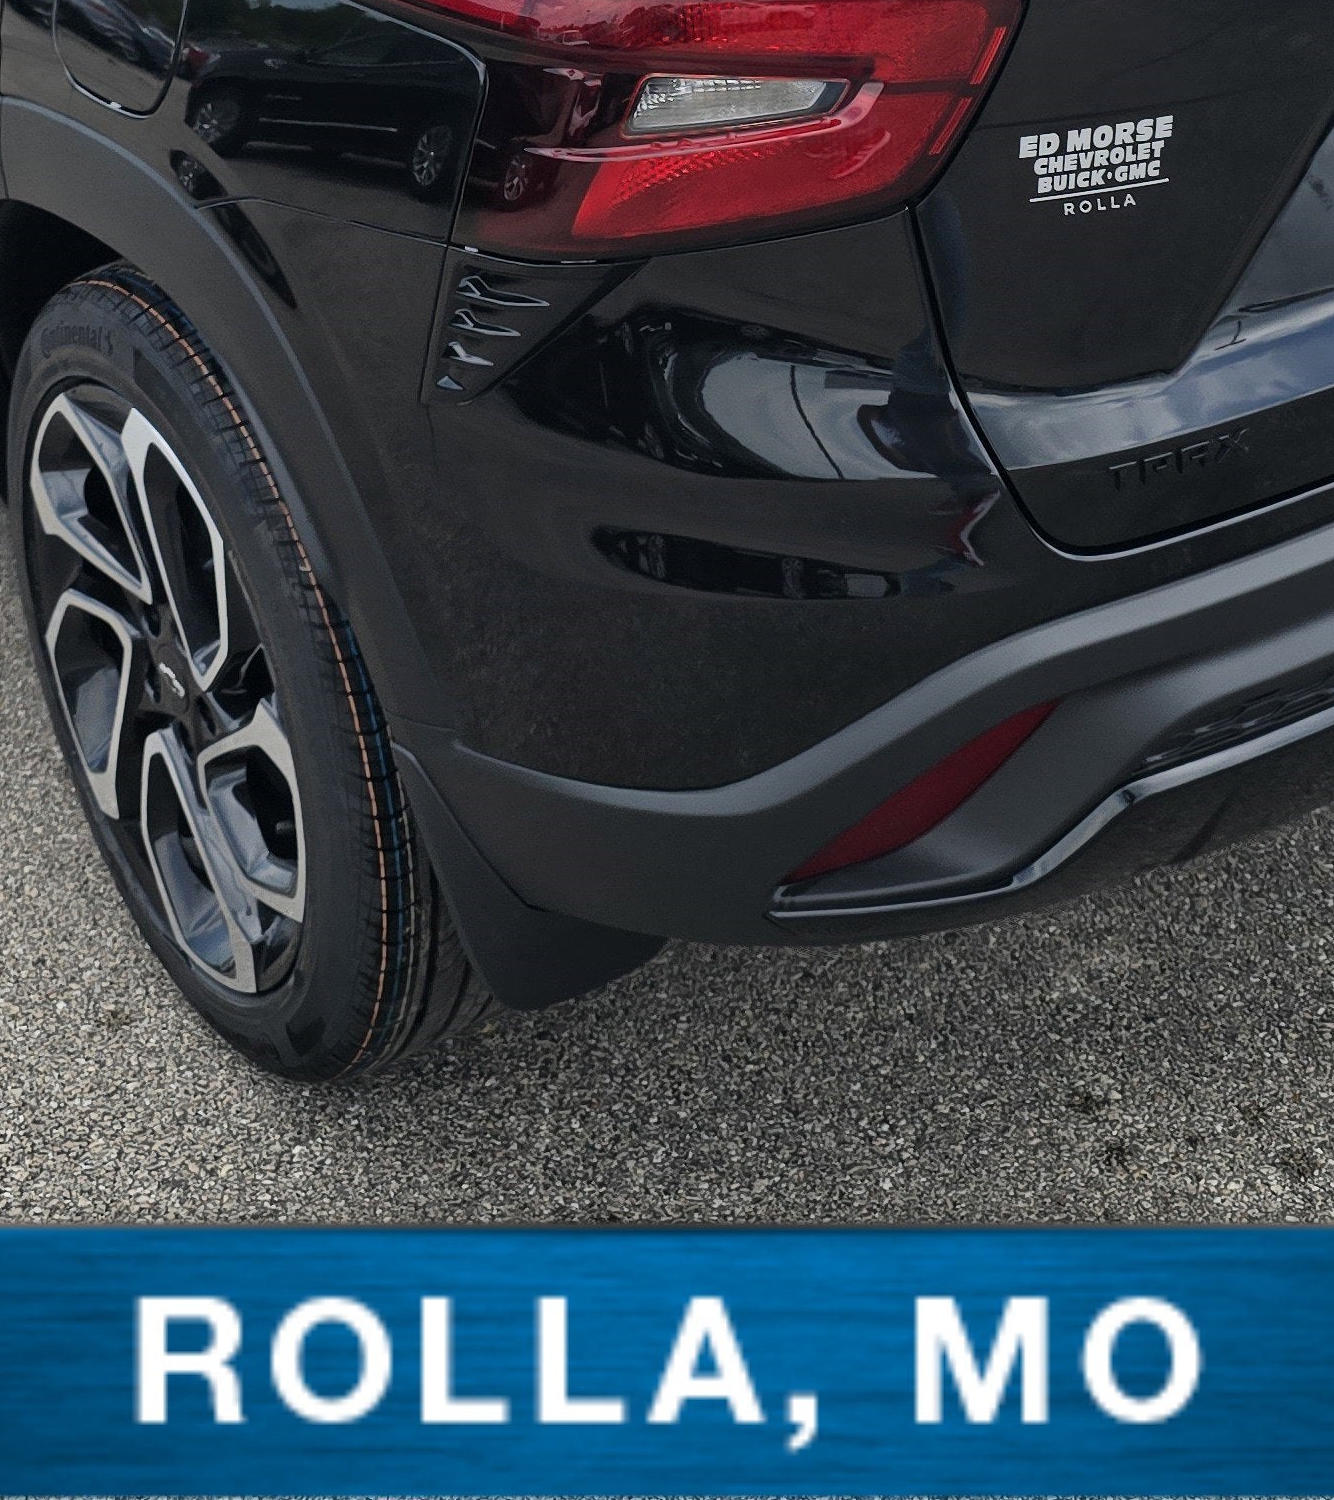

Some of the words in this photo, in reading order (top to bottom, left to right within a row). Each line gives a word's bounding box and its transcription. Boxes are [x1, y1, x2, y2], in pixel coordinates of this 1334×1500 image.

[1019, 132, 1060, 159] ED
[1067, 115, 1174, 153] MORSE
[1033, 140, 1165, 176] CHEVROLET
[1063, 193, 1136, 215] ROLLA
